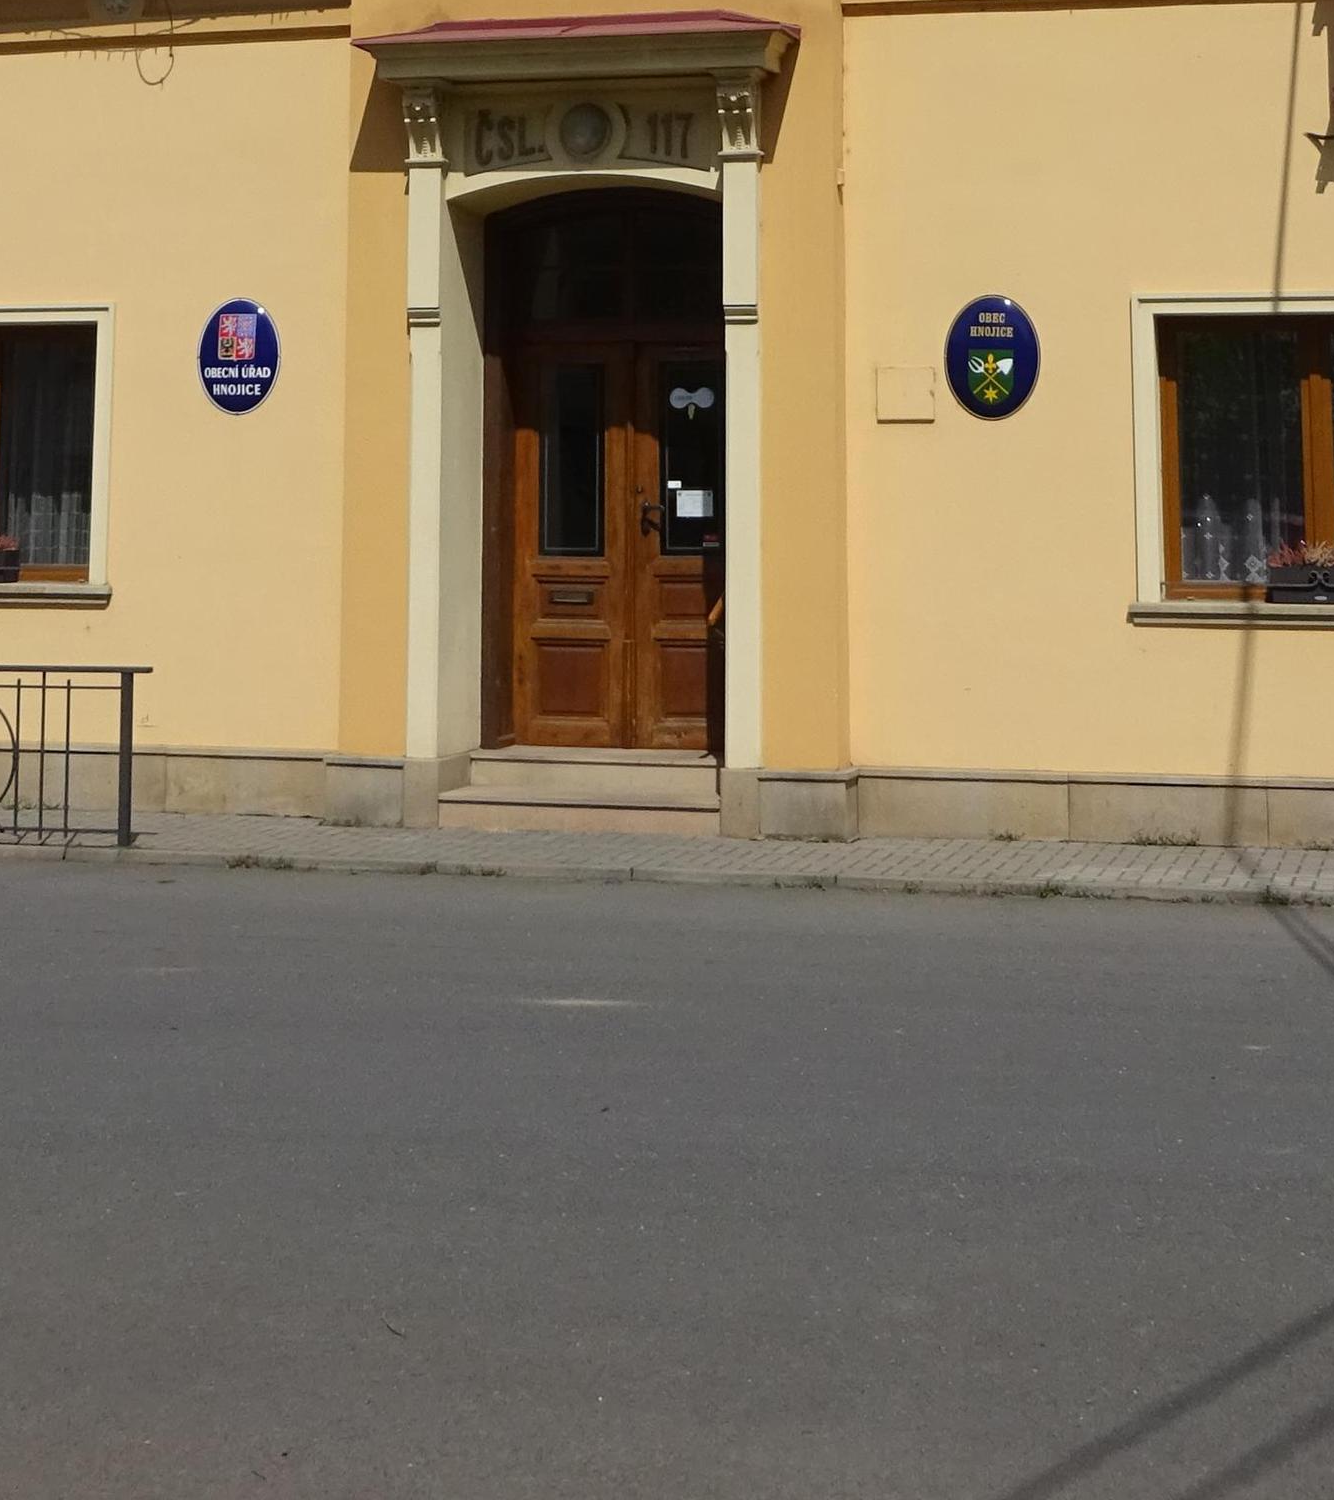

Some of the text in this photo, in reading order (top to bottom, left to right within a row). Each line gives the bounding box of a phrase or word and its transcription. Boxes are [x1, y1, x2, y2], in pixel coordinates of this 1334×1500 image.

[647, 111, 696, 159] 117
[979, 312, 1005, 323] OBEC
[970, 326, 1014, 337] HNOJICE
[204, 364, 271, 378] OBECNÍ ÚŘAD
[213, 384, 261, 396] HNOJICE
